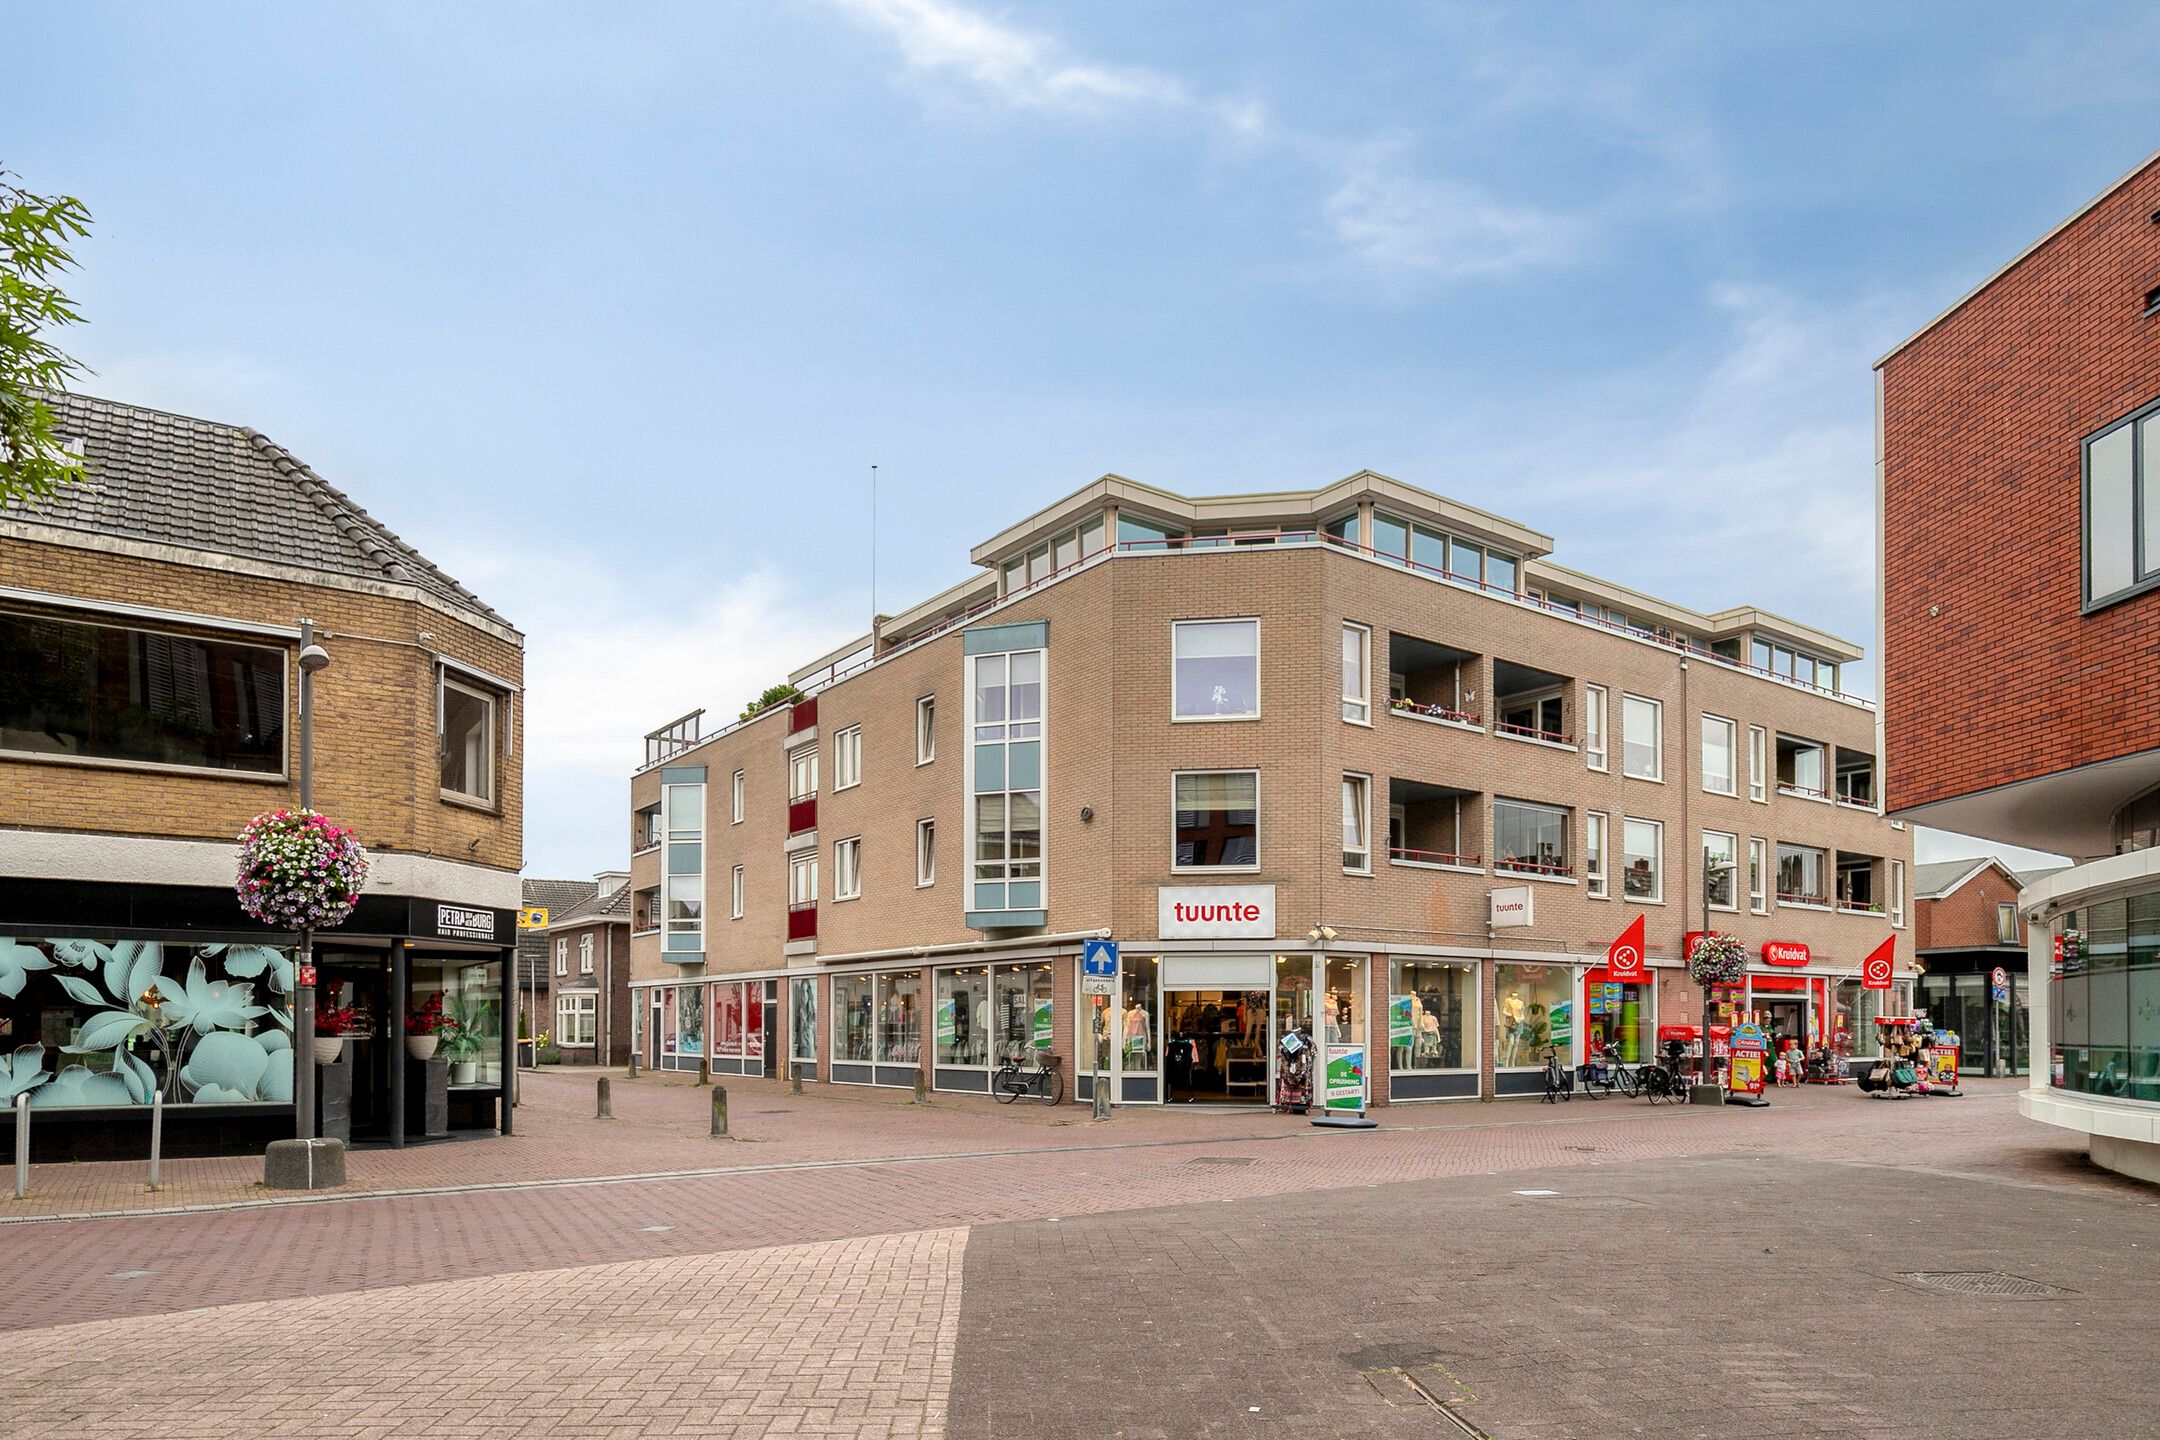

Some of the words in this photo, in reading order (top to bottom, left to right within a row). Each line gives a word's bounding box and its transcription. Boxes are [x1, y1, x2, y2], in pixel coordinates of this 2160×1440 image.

[1174, 902, 1260, 922] tuunte
[1496, 903, 1523, 912] tuunte
[440, 908, 465, 926] PETRA
[473, 913, 491, 929] BURG
[1778, 947, 1807, 961] Kruidvat
[1735, 1050, 1761, 1059] ACTIE!
